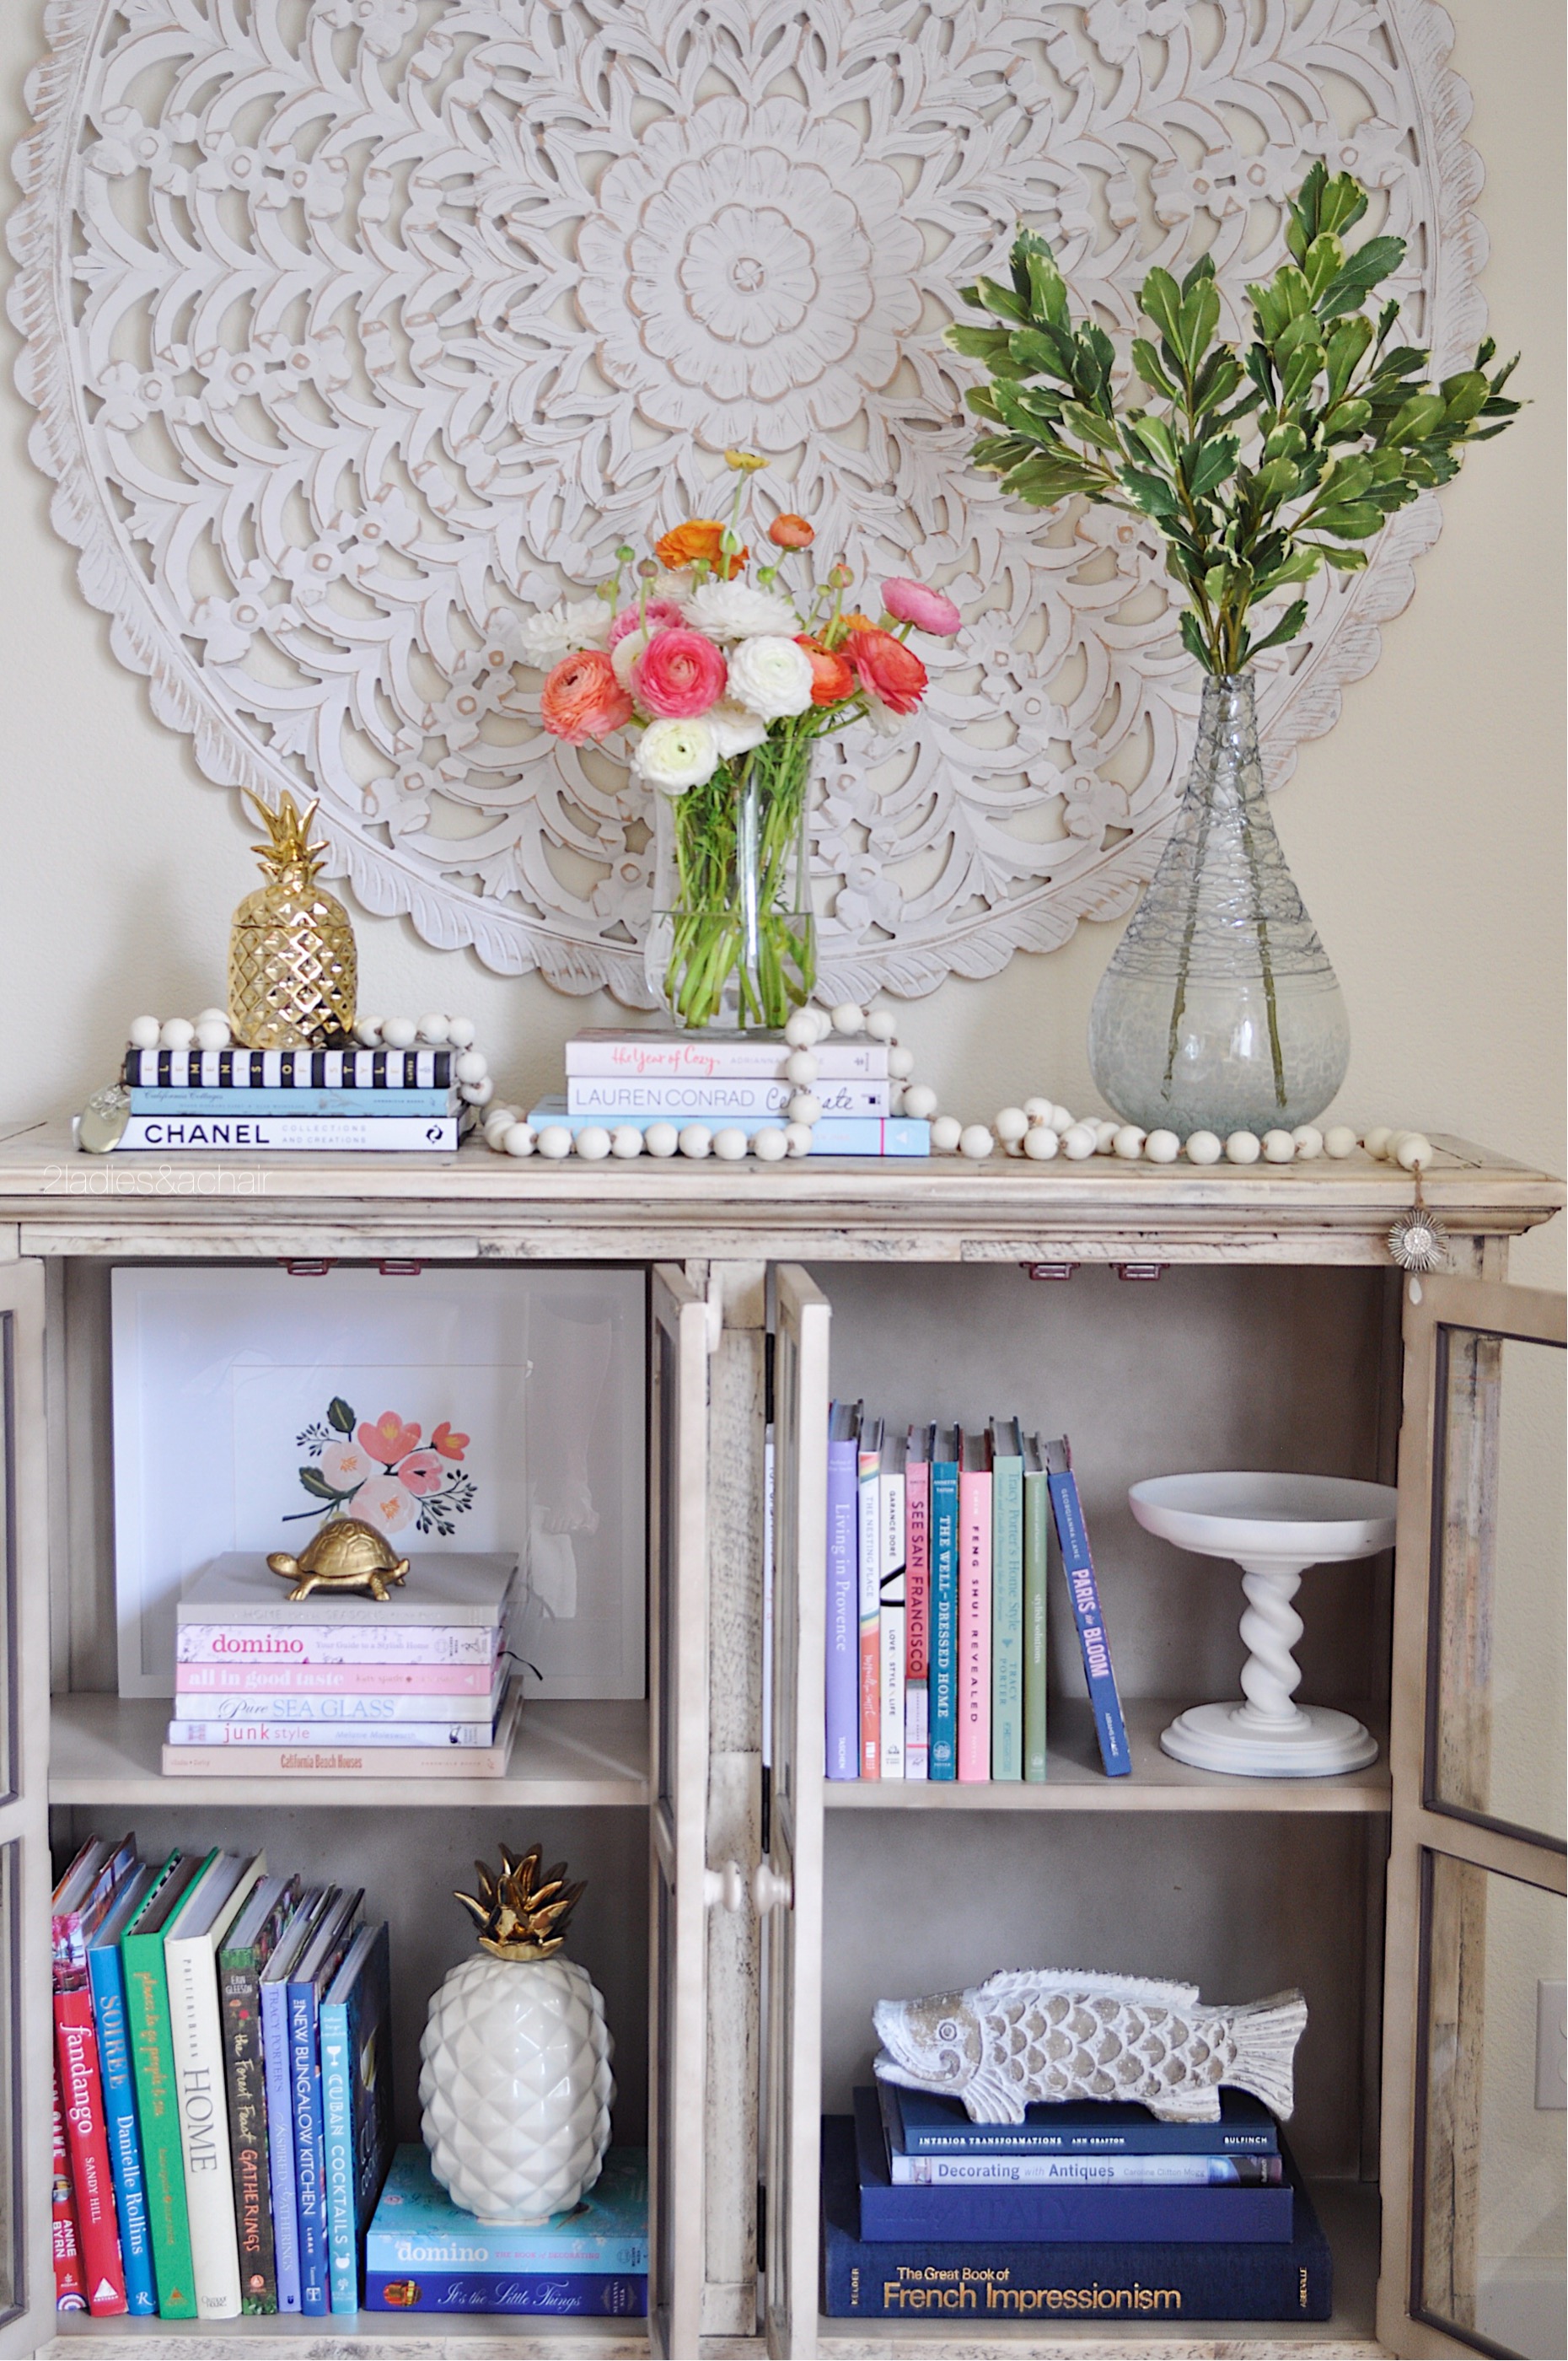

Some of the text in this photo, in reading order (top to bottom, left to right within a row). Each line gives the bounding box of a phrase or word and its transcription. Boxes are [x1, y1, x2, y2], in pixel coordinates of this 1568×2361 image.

[632, 1046, 666, 1073] Year
[668, 1049, 682, 1073] of
[576, 1089, 755, 1106] LAUREN CONRAD
[144, 1124, 271, 1143] CHANEL
[282, 1124, 367, 1132] COLLECTIONS
[1061, 1487, 1081, 1559] GEORGIANNA LANE
[971, 1525, 980, 1568] FENG
[1006, 1472, 1020, 1631] Tracy Porter's Home Style
[830, 1503, 851, 1652] Living in Provence
[866, 1567, 874, 1597] PLACE
[910, 1501, 924, 1672] SEE SAN FRANCISCO
[1071, 1568, 1097, 1614] PARIS
[937, 1515, 951, 1718] THE WELL-DRESSED HOME
[1033, 1593, 1044, 1665] stylish solutions
[212, 1633, 304, 1654] domino
[1082, 1627, 1109, 1678] BLOOM
[188, 1668, 344, 1689] all in good taste
[970, 1629, 979, 1723] REVEALED
[998, 1658, 1007, 1706] PORTER
[1008, 1663, 1018, 1702] TRACY
[217, 1697, 395, 1719] Pure SEA GLASS
[223, 1723, 310, 1744] junk style
[838, 1736, 846, 1769] TASCHEN
[280, 1753, 363, 1769] California Beach Houses
[268, 1988, 285, 2093] TRACY PORTER'S
[60, 2022, 94, 2134] fandango
[183, 2066, 217, 2173] HOME
[293, 2005, 316, 2216] NEW BUNGALOW KITCHEN
[234, 2033, 260, 2253] the Forest Feast GATHERINGS
[328, 2073, 348, 2245] CUBAN COCKTAILS
[919, 2137, 966, 2145] INTERIOR
[969, 2137, 1062, 2145] TRANSFORMATIONS
[1224, 2136, 1268, 2144] BULFINCH
[84, 2156, 102, 2224] SANDY HILL
[117, 2114, 147, 2256] Danielle Rollins
[937, 2163, 1020, 2180] Decorating
[1023, 2165, 1044, 2177] with
[1049, 2163, 1115, 2181] Antiques
[1123, 2167, 1155, 2177] Caroline
[1184, 2168, 1206, 2179] Mogg
[52, 2221, 66, 2259] BYRN
[62, 2218, 77, 2257] ANNE
[276, 2184, 295, 2272] GATHERINGS
[397, 2241, 489, 2262] domino
[548, 2251, 600, 2260] DECORATING
[850, 2267, 860, 2305] KELDER
[896, 2266, 1011, 2281] The Great Book of
[437, 2280, 583, 2314] It's the Little Things
[883, 2281, 1182, 2313] French Impressionism
